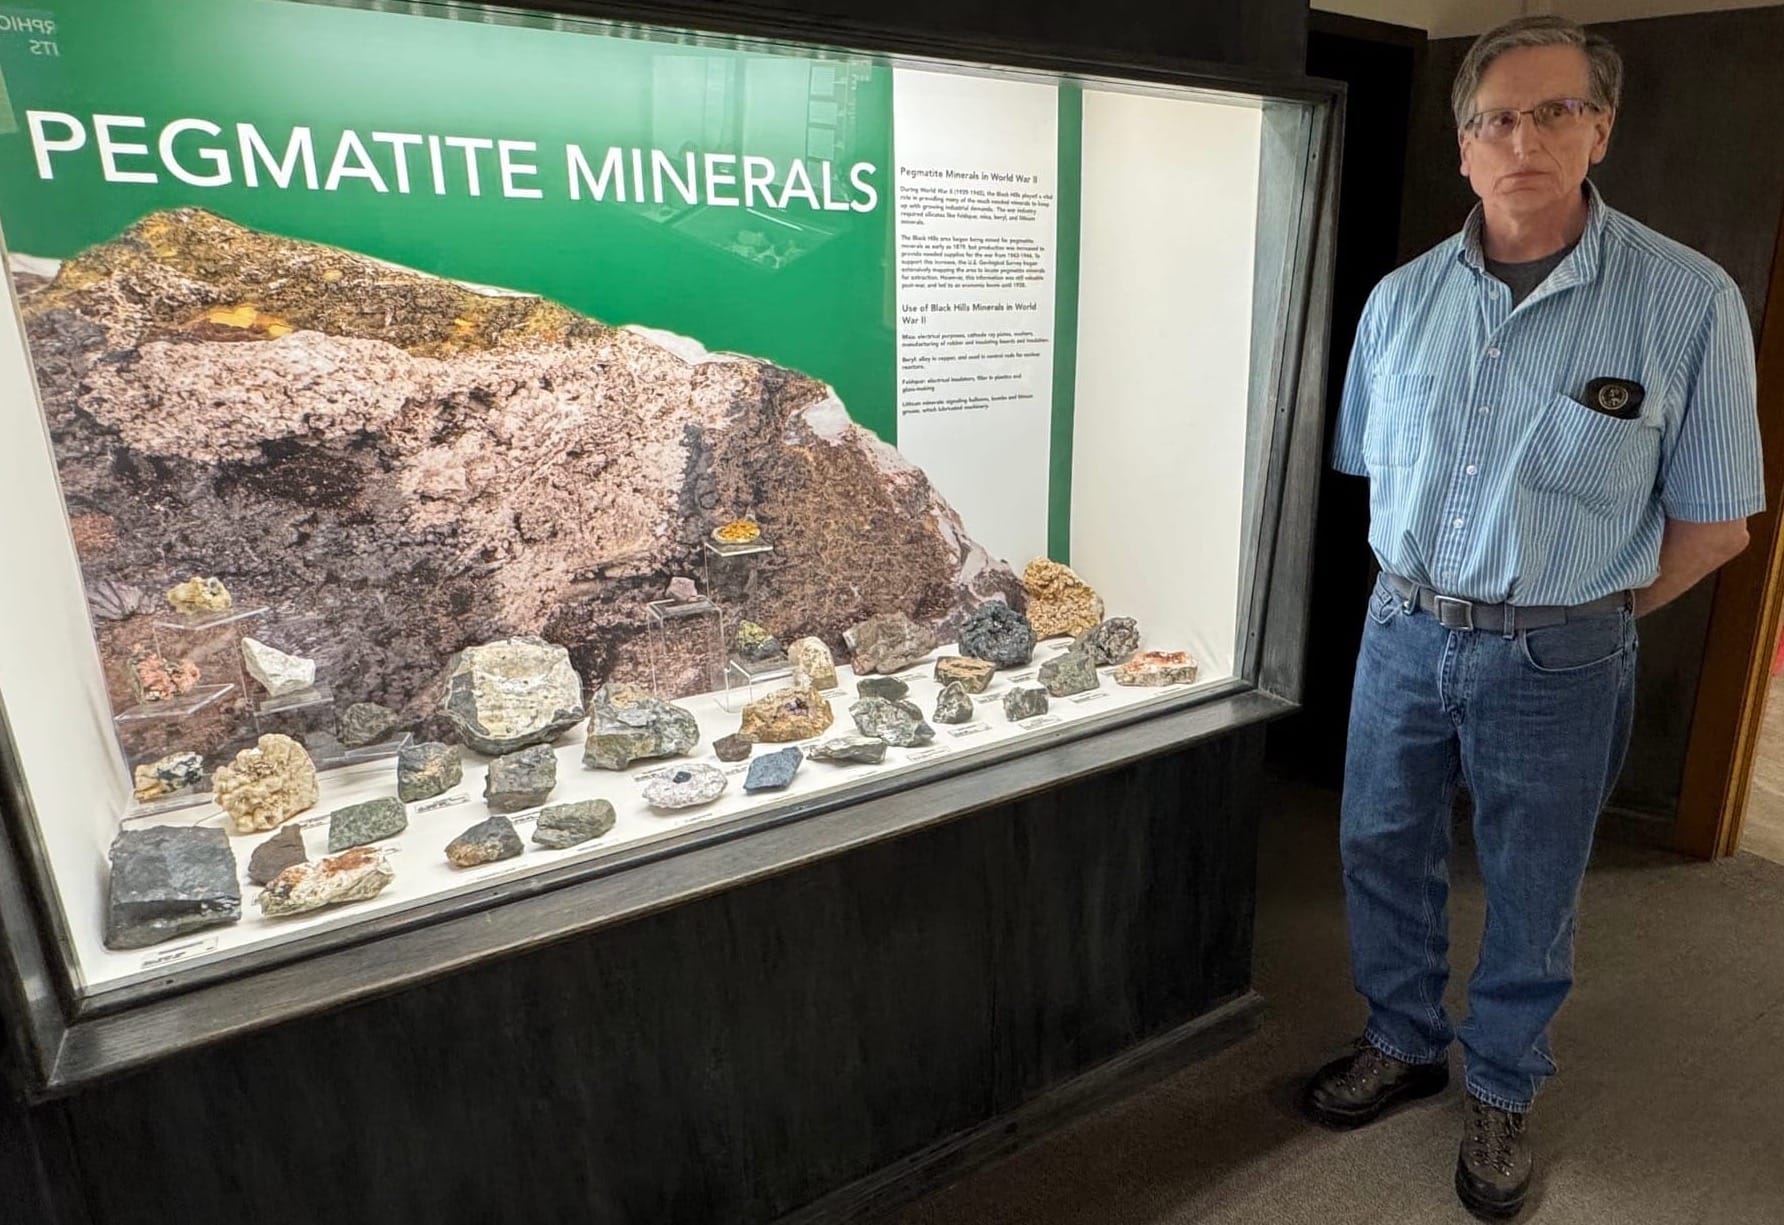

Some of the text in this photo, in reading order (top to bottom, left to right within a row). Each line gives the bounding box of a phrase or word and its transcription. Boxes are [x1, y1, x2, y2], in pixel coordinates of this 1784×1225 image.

[26, 110, 877, 213] PEGMATITE MINERALS
[900, 167, 943, 179] Pegmatite
[946, 170, 979, 180] Minerals
[981, 172, 989, 181] in
[990, 172, 1014, 182] World
[1015, 174, 1031, 183] War
[902, 303, 1037, 313] Use of Black Hills Minerals in World
[902, 316, 918, 324] War
